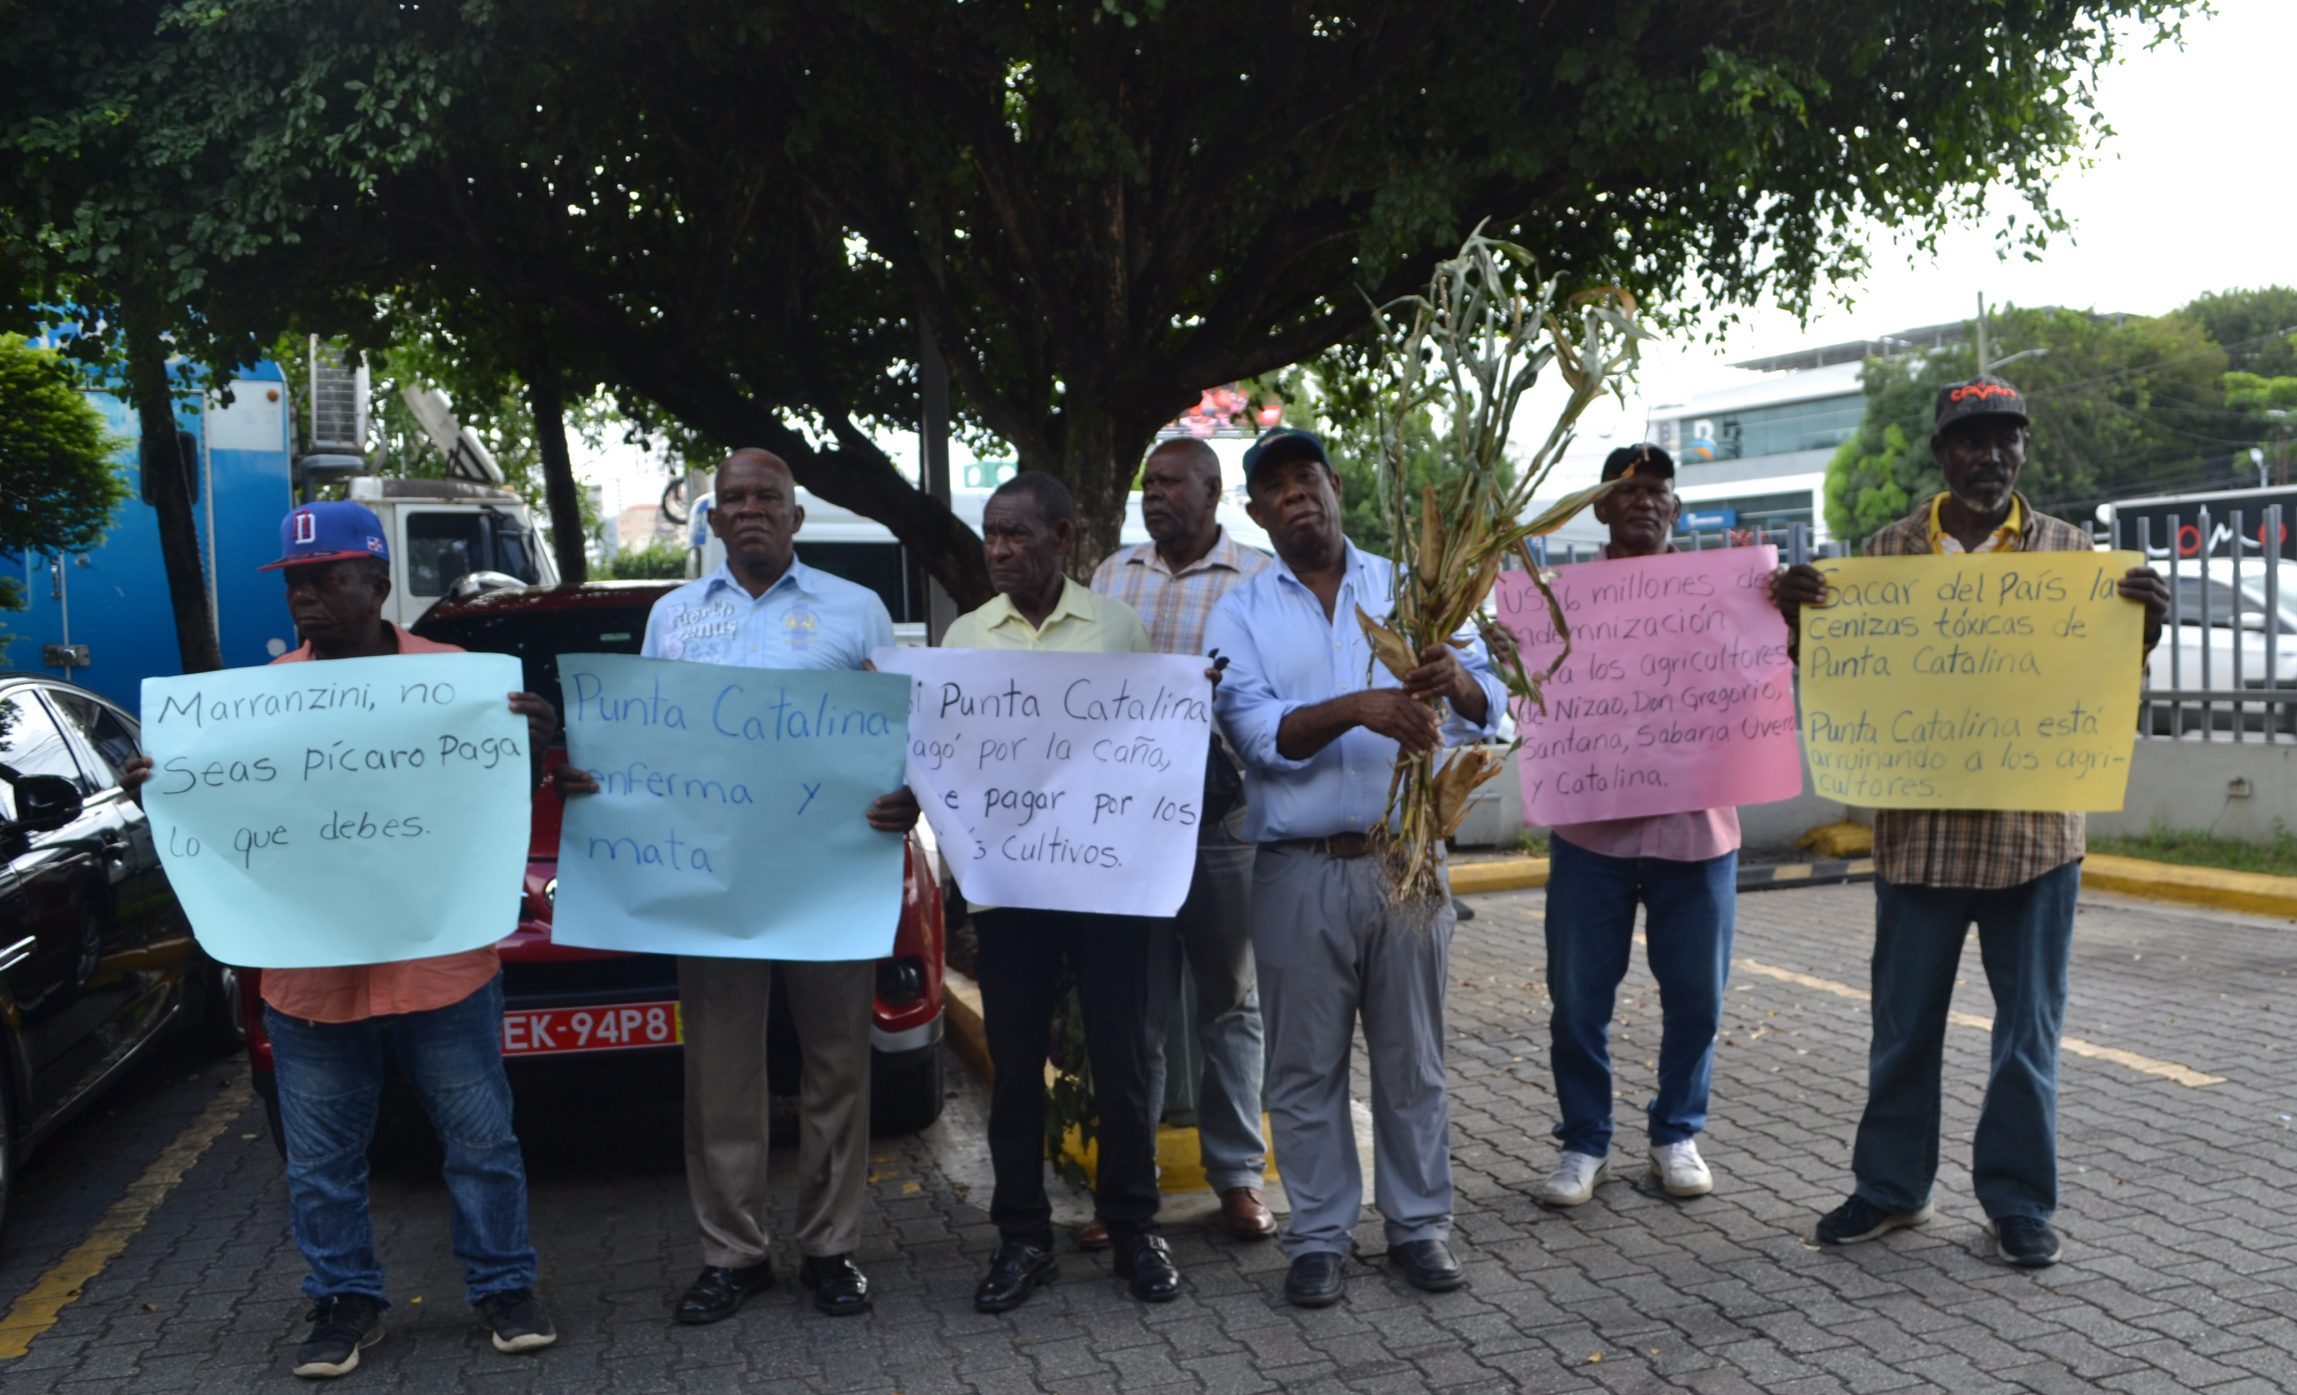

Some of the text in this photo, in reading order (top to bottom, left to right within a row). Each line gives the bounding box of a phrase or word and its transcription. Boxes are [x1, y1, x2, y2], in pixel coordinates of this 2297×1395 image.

[1592, 570, 1715, 607] millones
[1737, 565, 1767, 589] de
[1937, 571, 1984, 602] del
[1517, 603, 1726, 647] ndemnización
[1933, 607, 2035, 638] tóxicas
[2053, 605, 2087, 638] de
[1590, 652, 1625, 681] los
[1641, 636, 1789, 687] agricultores
[1811, 643, 2042, 678] Punta Catalina
[157, 682, 456, 728] Marranzini, no
[572, 672, 891, 742] Punta Catalina
[940, 678, 1040, 719] Punta
[1064, 678, 1208, 724] Catalina
[1809, 699, 2103, 743] Punta Catalina está
[907, 732, 961, 771] agó
[978, 738, 1028, 770] por
[1046, 731, 1071, 761] la
[1523, 726, 1629, 761] Santana,
[1637, 720, 1730, 747] Sabana
[1811, 741, 2125, 780] arruinando a los agri-
[162, 756, 277, 796] Seas
[304, 740, 425, 781] pícaro
[1556, 763, 1668, 795] Catalina.
[797, 782, 821, 815] y
[984, 787, 1066, 826] pagar
[1093, 792, 1133, 825] por
[1152, 795, 1197, 825] los
[233, 824, 289, 869] que
[320, 811, 431, 841] debes.
[588, 828, 713, 873] mata
[503, 1008, 668, 1050] EK-94P8
